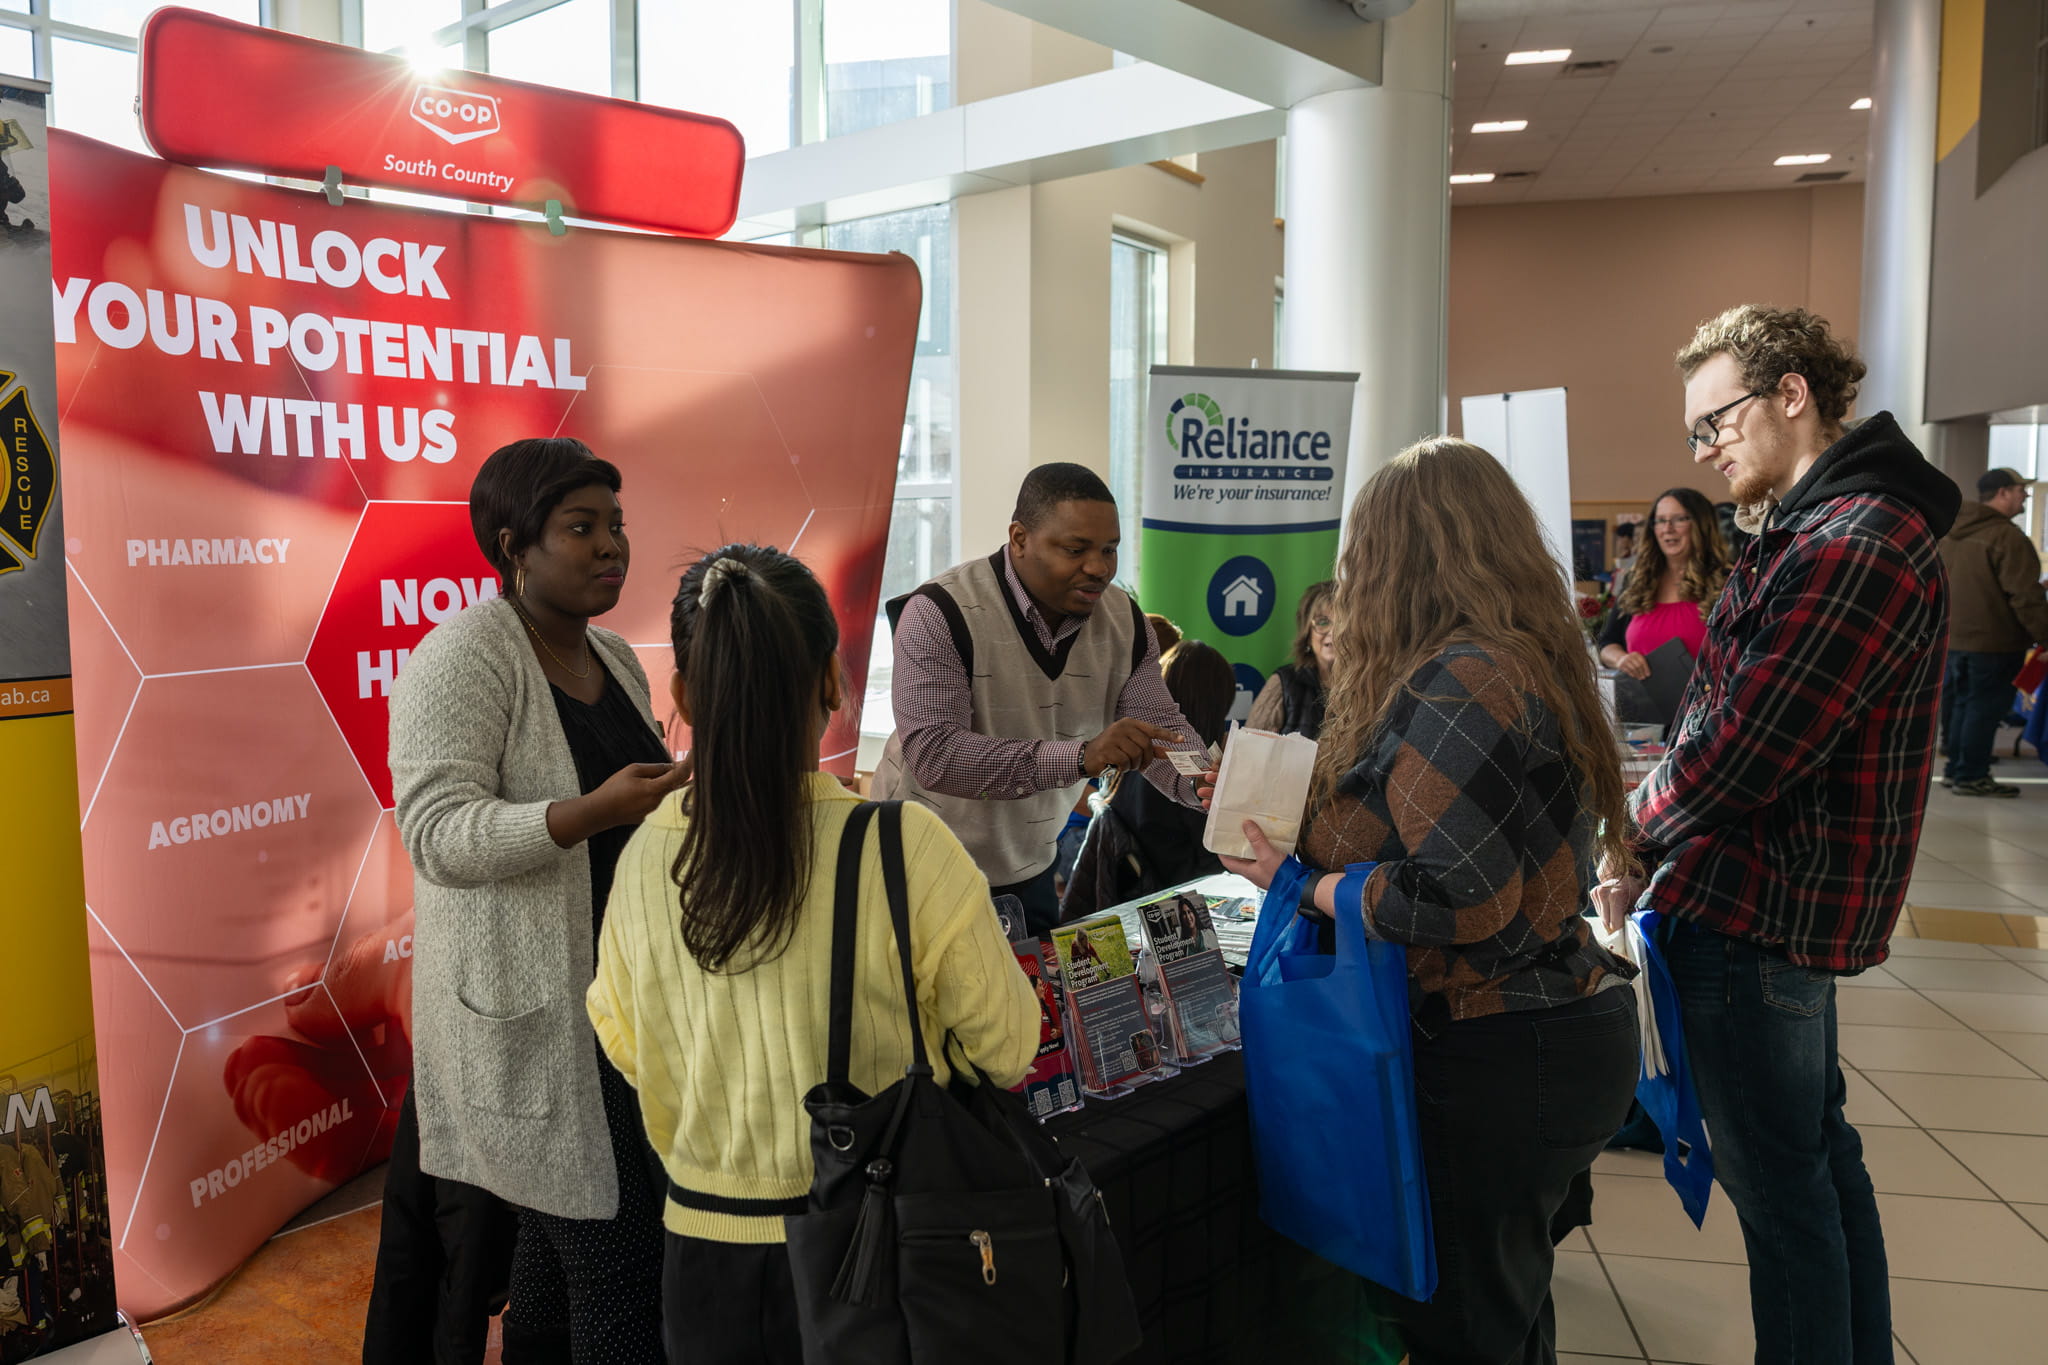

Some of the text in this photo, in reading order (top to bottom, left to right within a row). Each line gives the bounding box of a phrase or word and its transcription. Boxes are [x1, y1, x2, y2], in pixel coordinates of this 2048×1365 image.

[384, 154, 514, 193] South Country
[184, 203, 451, 300] UNLOCK
[52, 276, 587, 391] YOUR POTENTIAL
[198, 391, 457, 464] WITH US
[1181, 417, 1331, 461] Reliance
[14, 418, 33, 530] RESCUE
[1188, 467, 1316, 479] INSURANCE
[1173, 484, 1332, 504] We're your insurance!
[126, 538, 291, 567] PHARMACY
[148, 793, 312, 850] AGRONOMY
[1153, 933, 1178, 946] Student
[1156, 937, 1195, 954] Development
[1066, 958, 1091, 971] Student
[1158, 949, 1184, 961] Program
[1069, 961, 1109, 979] Development
[1071, 975, 1097, 988] Program
[190, 1098, 353, 1209] PROFESSIONAL
